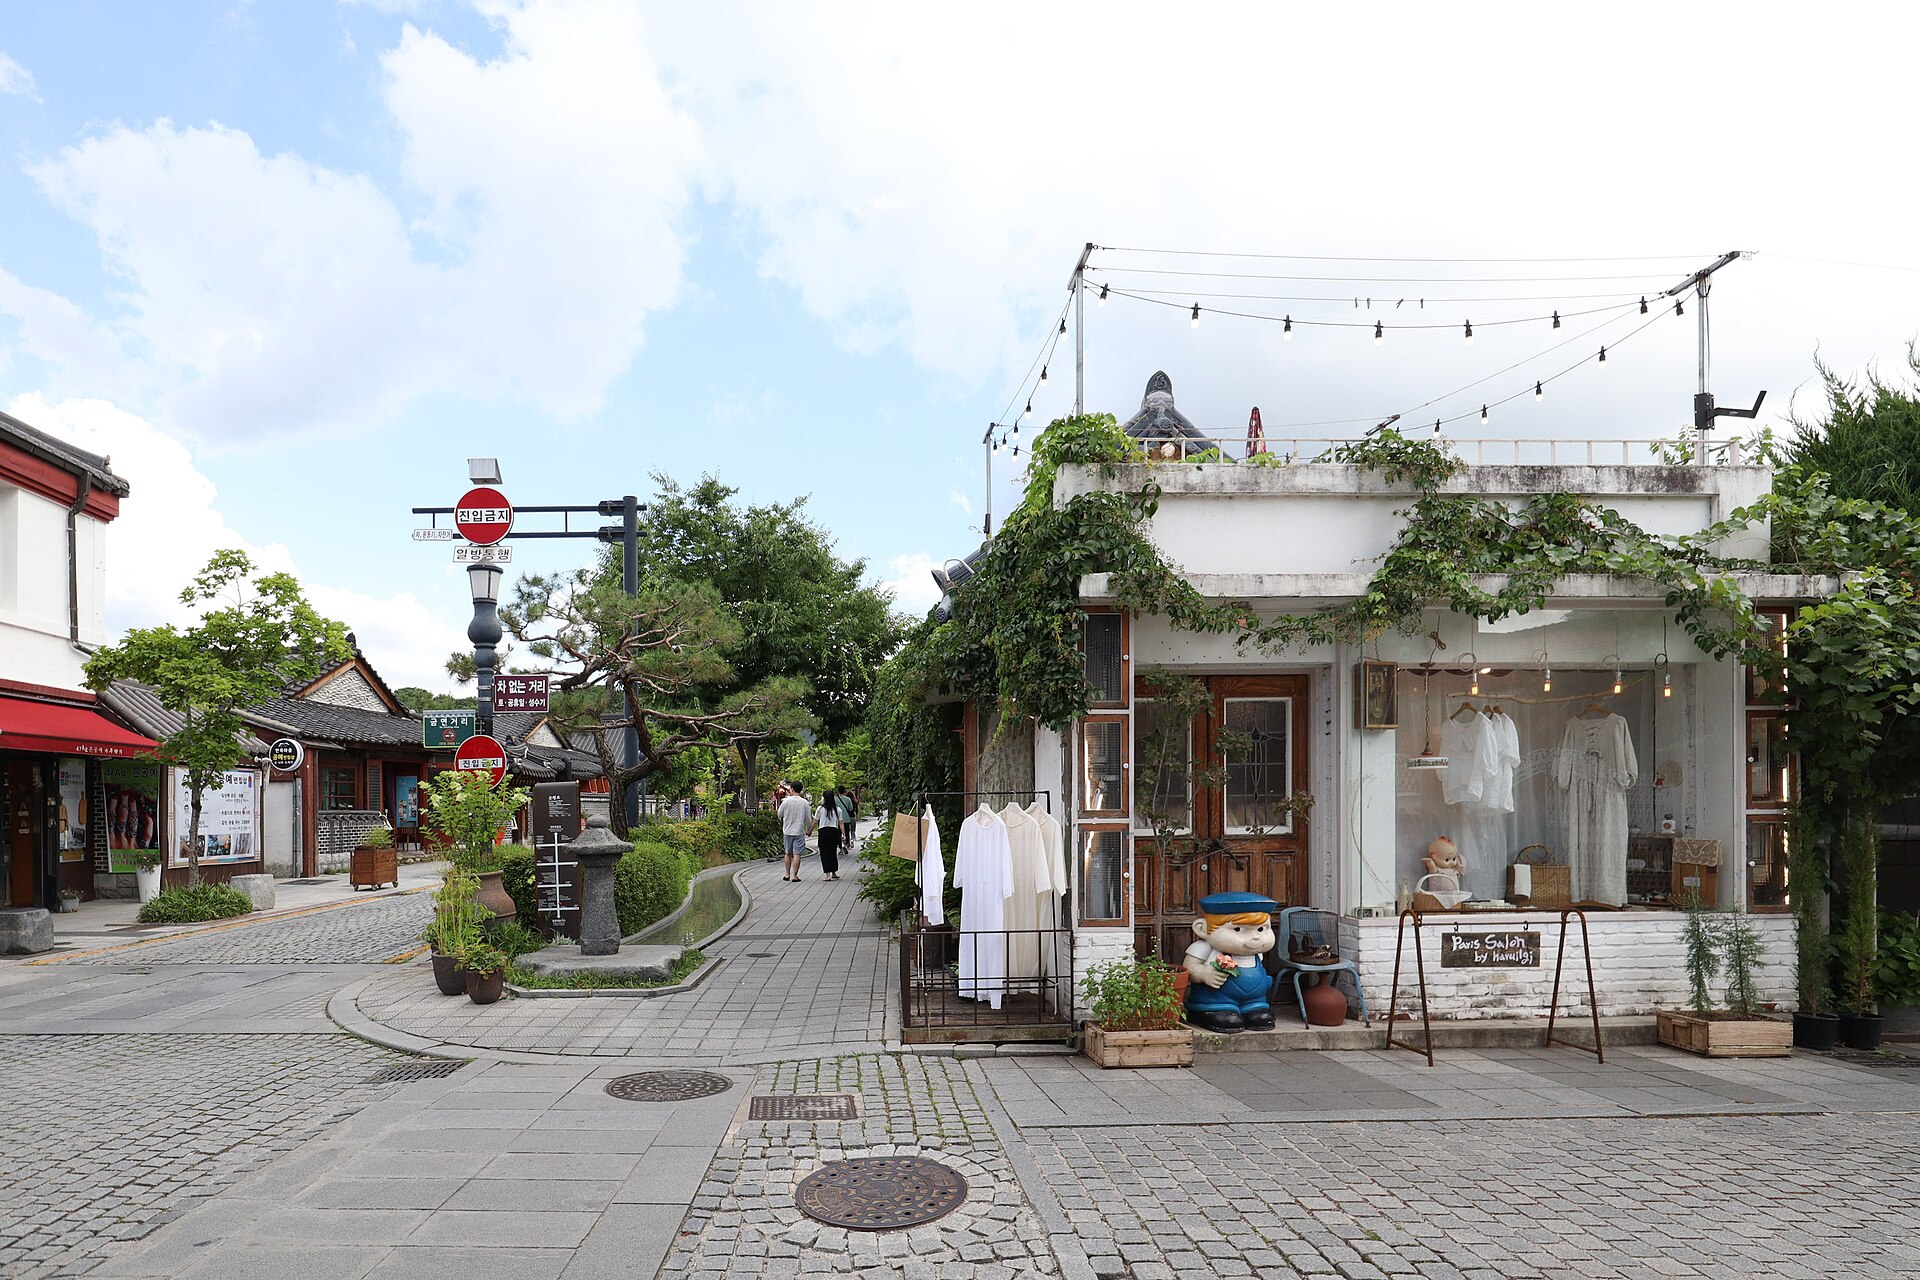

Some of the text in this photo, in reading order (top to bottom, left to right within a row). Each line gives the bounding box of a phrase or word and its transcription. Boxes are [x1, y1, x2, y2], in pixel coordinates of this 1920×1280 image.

[459, 509, 508, 522] 진입금지
[456, 549, 510, 560] 일방통행
[497, 680, 546, 694] 차 없는 거리
[430, 717, 468, 726] 금연거리
[132, 767, 158, 778] 은공예
[1452, 934, 1526, 951] Paris Salon
[1474, 951, 1488, 964] by
